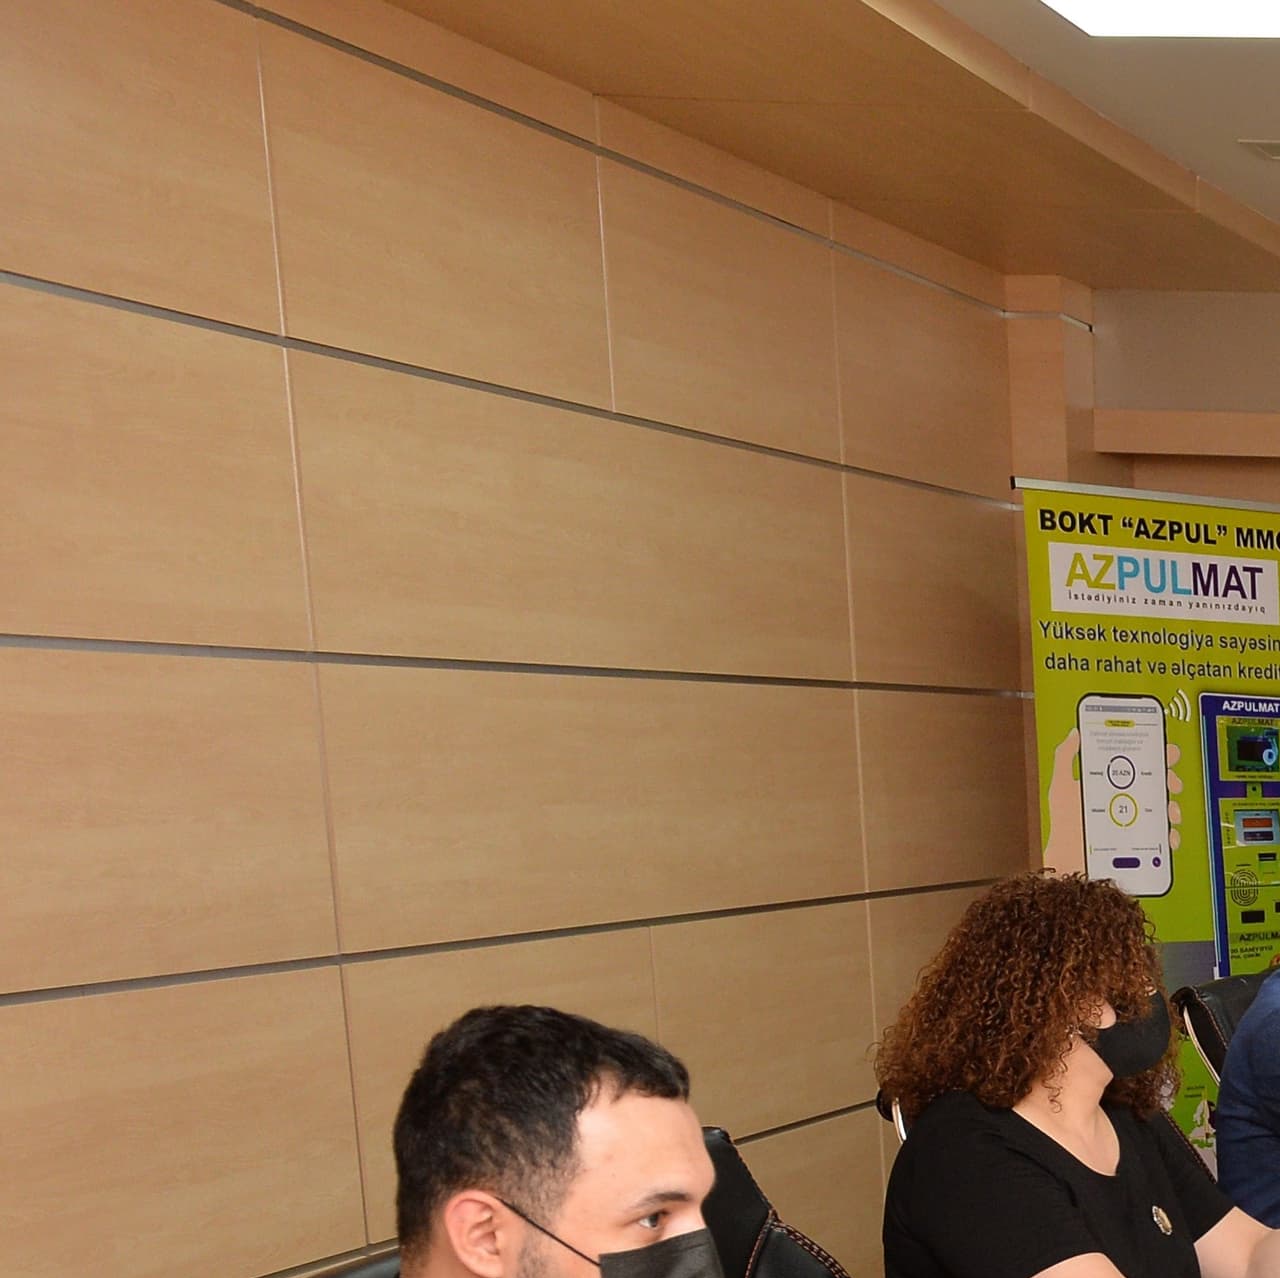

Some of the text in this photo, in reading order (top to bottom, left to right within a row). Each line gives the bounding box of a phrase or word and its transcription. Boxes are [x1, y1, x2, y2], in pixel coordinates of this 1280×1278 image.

[1039, 508, 1113, 536] BOKT
[1065, 551, 1264, 601] AZPULMAT
[1144, 598, 1182, 608] zaman
[1039, 619, 1107, 642] Yüksək
[1112, 626, 1213, 651] texnologiya
[1045, 652, 1090, 672] daha
[1095, 656, 1142, 674] rahat
[1147, 661, 1167, 675] və
[1171, 659, 1232, 680] əlçatan
[1222, 701, 1280, 713] AZPULMAT
